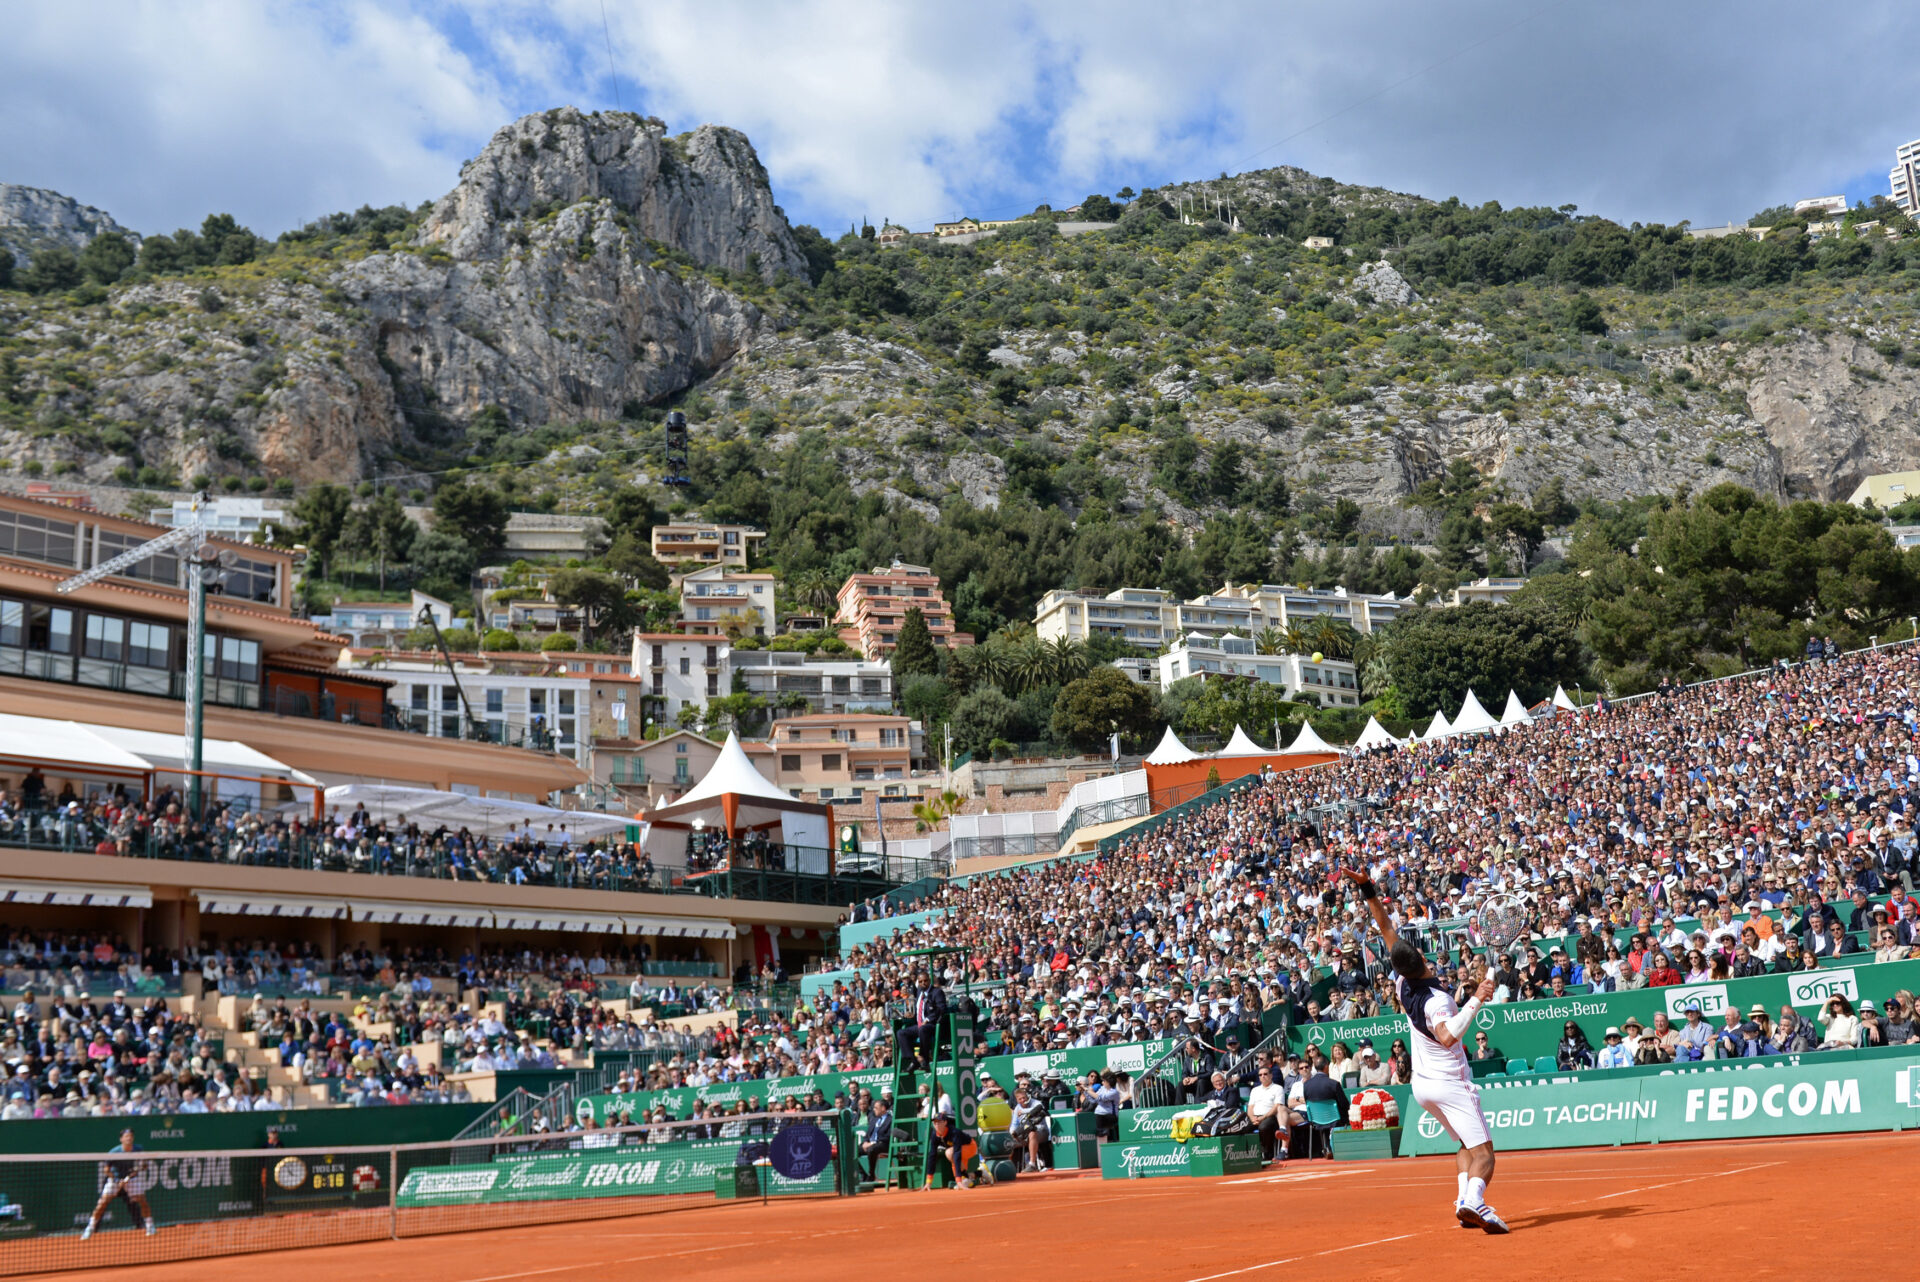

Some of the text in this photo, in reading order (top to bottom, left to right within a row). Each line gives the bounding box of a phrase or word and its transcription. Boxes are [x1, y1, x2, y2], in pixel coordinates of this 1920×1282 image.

[1503, 1001, 1608, 1024] Mercedes-Benz
[1331, 1019, 1411, 1042] Mercedes-Be
[1112, 1059, 1142, 1069] Adecco
[1685, 1079, 1862, 1122] FEDCOM
[1486, 1100, 1657, 1129] RGIO TACCHINI
[1117, 1146, 1190, 1168] Façonnable
[582, 1160, 661, 1187] FEDCOM
